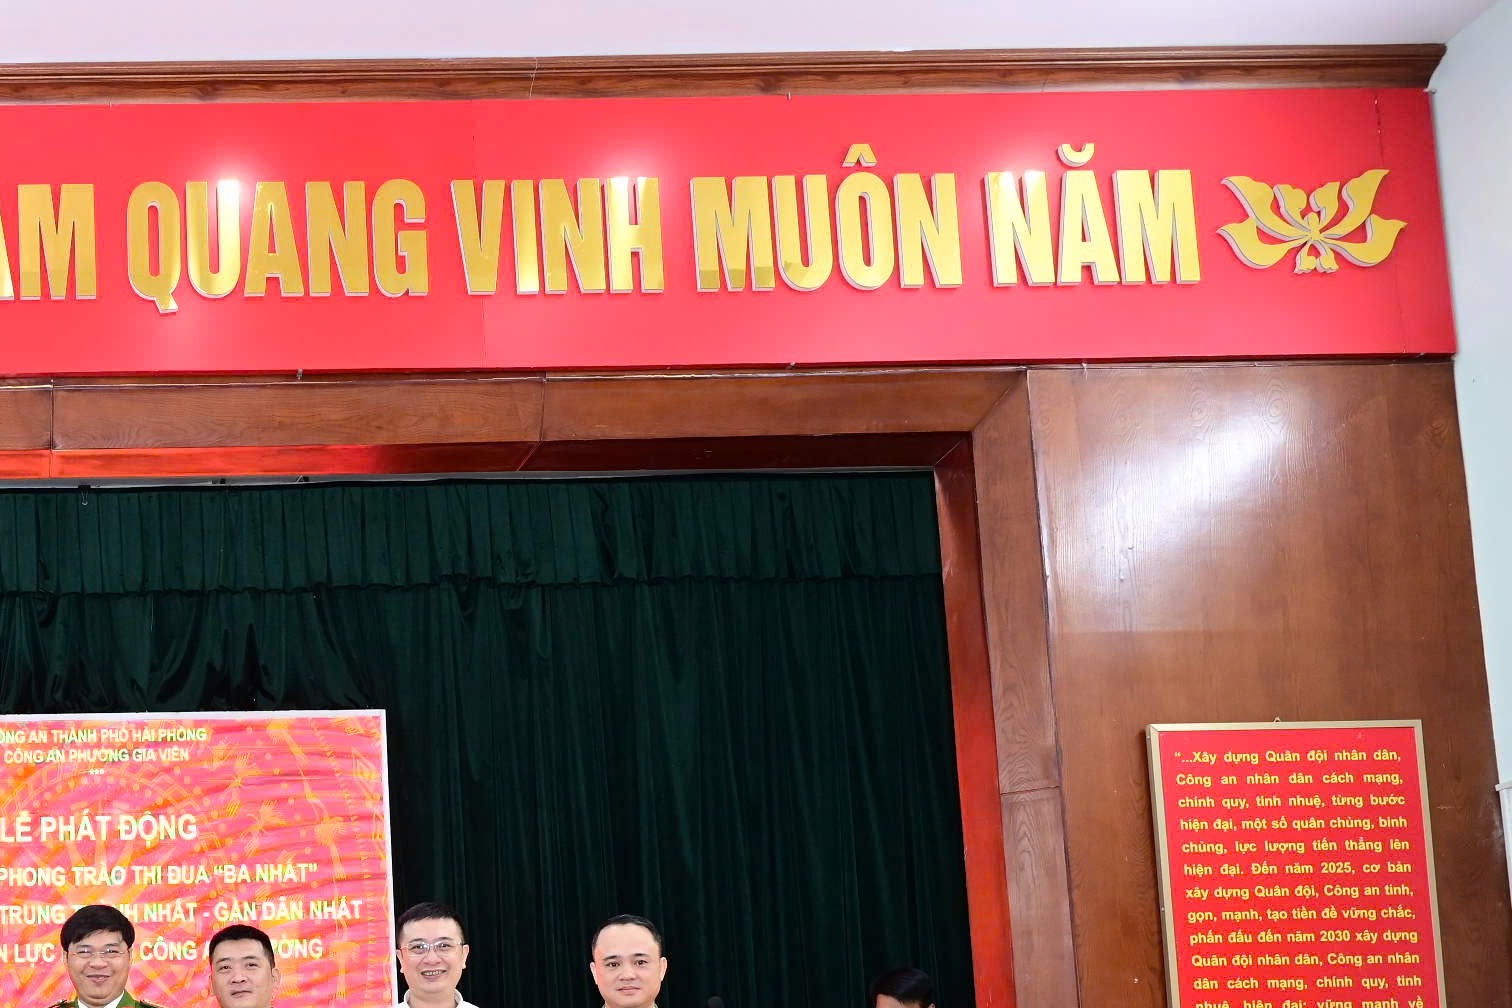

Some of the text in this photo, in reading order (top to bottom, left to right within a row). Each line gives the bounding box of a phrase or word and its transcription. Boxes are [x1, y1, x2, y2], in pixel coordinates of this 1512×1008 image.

[127, 179, 428, 314] QUANG
[451, 175, 664, 295] VINH
[689, 143, 962, 292] MUÔN
[987, 141, 1201, 288] NĂM
[29, 730, 47, 743] AN
[4, 748, 43, 763] CÔNG
[46, 750, 65, 762] AN
[132, 749, 156, 761] GIA
[1224, 752, 1258, 764] dựng
[1266, 750, 1300, 762] Quân
[1307, 750, 1327, 763] đội
[1335, 750, 1366, 760] nhân
[1374, 749, 1400, 761] dân,
[1178, 794, 1405, 809] chính quy, tinh nhuệ, từng bước
[40, 808, 112, 841] PHÁT
[118, 810, 198, 848] ĐỘNG
[1182, 837, 1409, 854] chủng, lực lượng tiến thẳng lên
[72, 862, 126, 886] TRÀO
[131, 866, 162, 885] THI
[167, 865, 210, 885] ĐUA
[1184, 861, 1411, 877] hiện đại. Đến năm 2025, cơ bản
[262, 897, 305, 920] DÂN
[1190, 929, 1417, 946] phấn đấu đến năm 2030 xây dựng
[14, 943, 55, 968] LỰC
[139, 935, 195, 960] CÔNG
